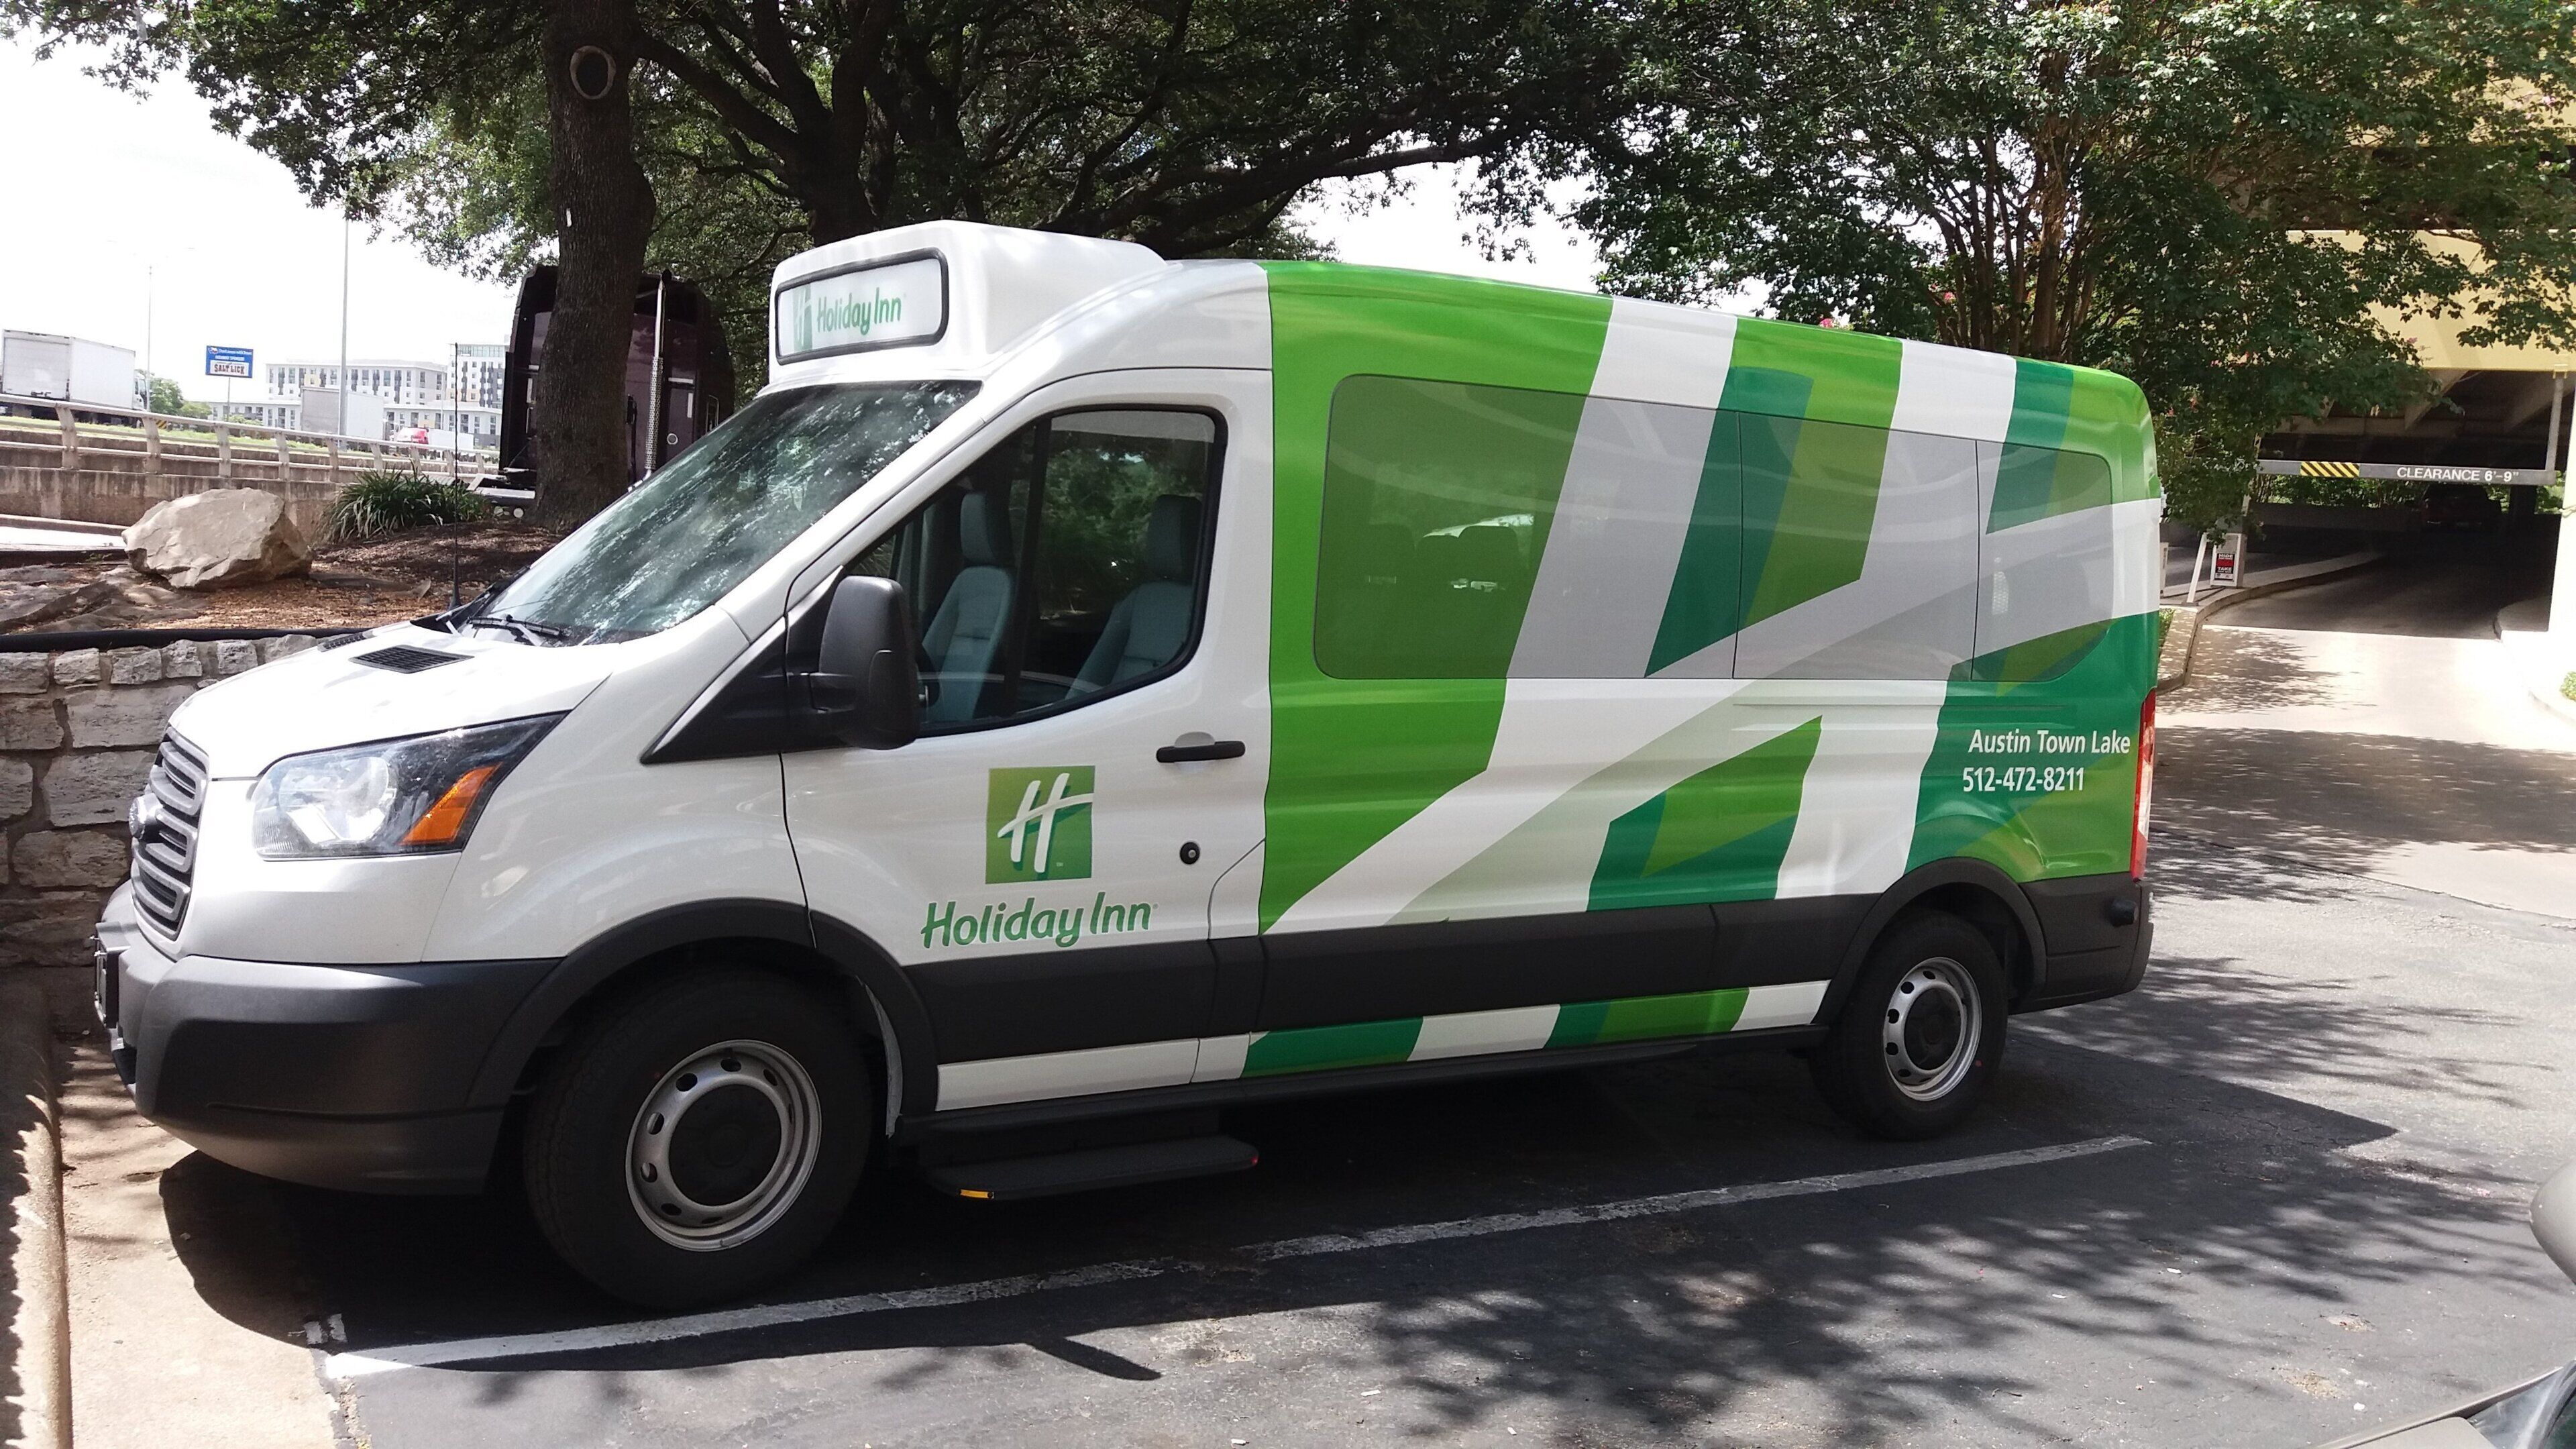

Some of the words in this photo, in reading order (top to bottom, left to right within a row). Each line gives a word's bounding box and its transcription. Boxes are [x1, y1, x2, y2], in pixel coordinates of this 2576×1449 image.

[816, 292, 871, 335] Holiday
[874, 286, 902, 324] Inn
[214, 364, 229, 373] SALT
[230, 365, 245, 375] LICK
[2396, 467, 2480, 481] CLEARANCE
[1968, 729, 2031, 753] Austin
[2037, 730, 2086, 753] Town
[2091, 729, 2131, 754] Lake
[1962, 767, 2084, 792] 512-472-8211
[920, 897, 1085, 949] Holiday
[1089, 891, 1152, 934] Inn
